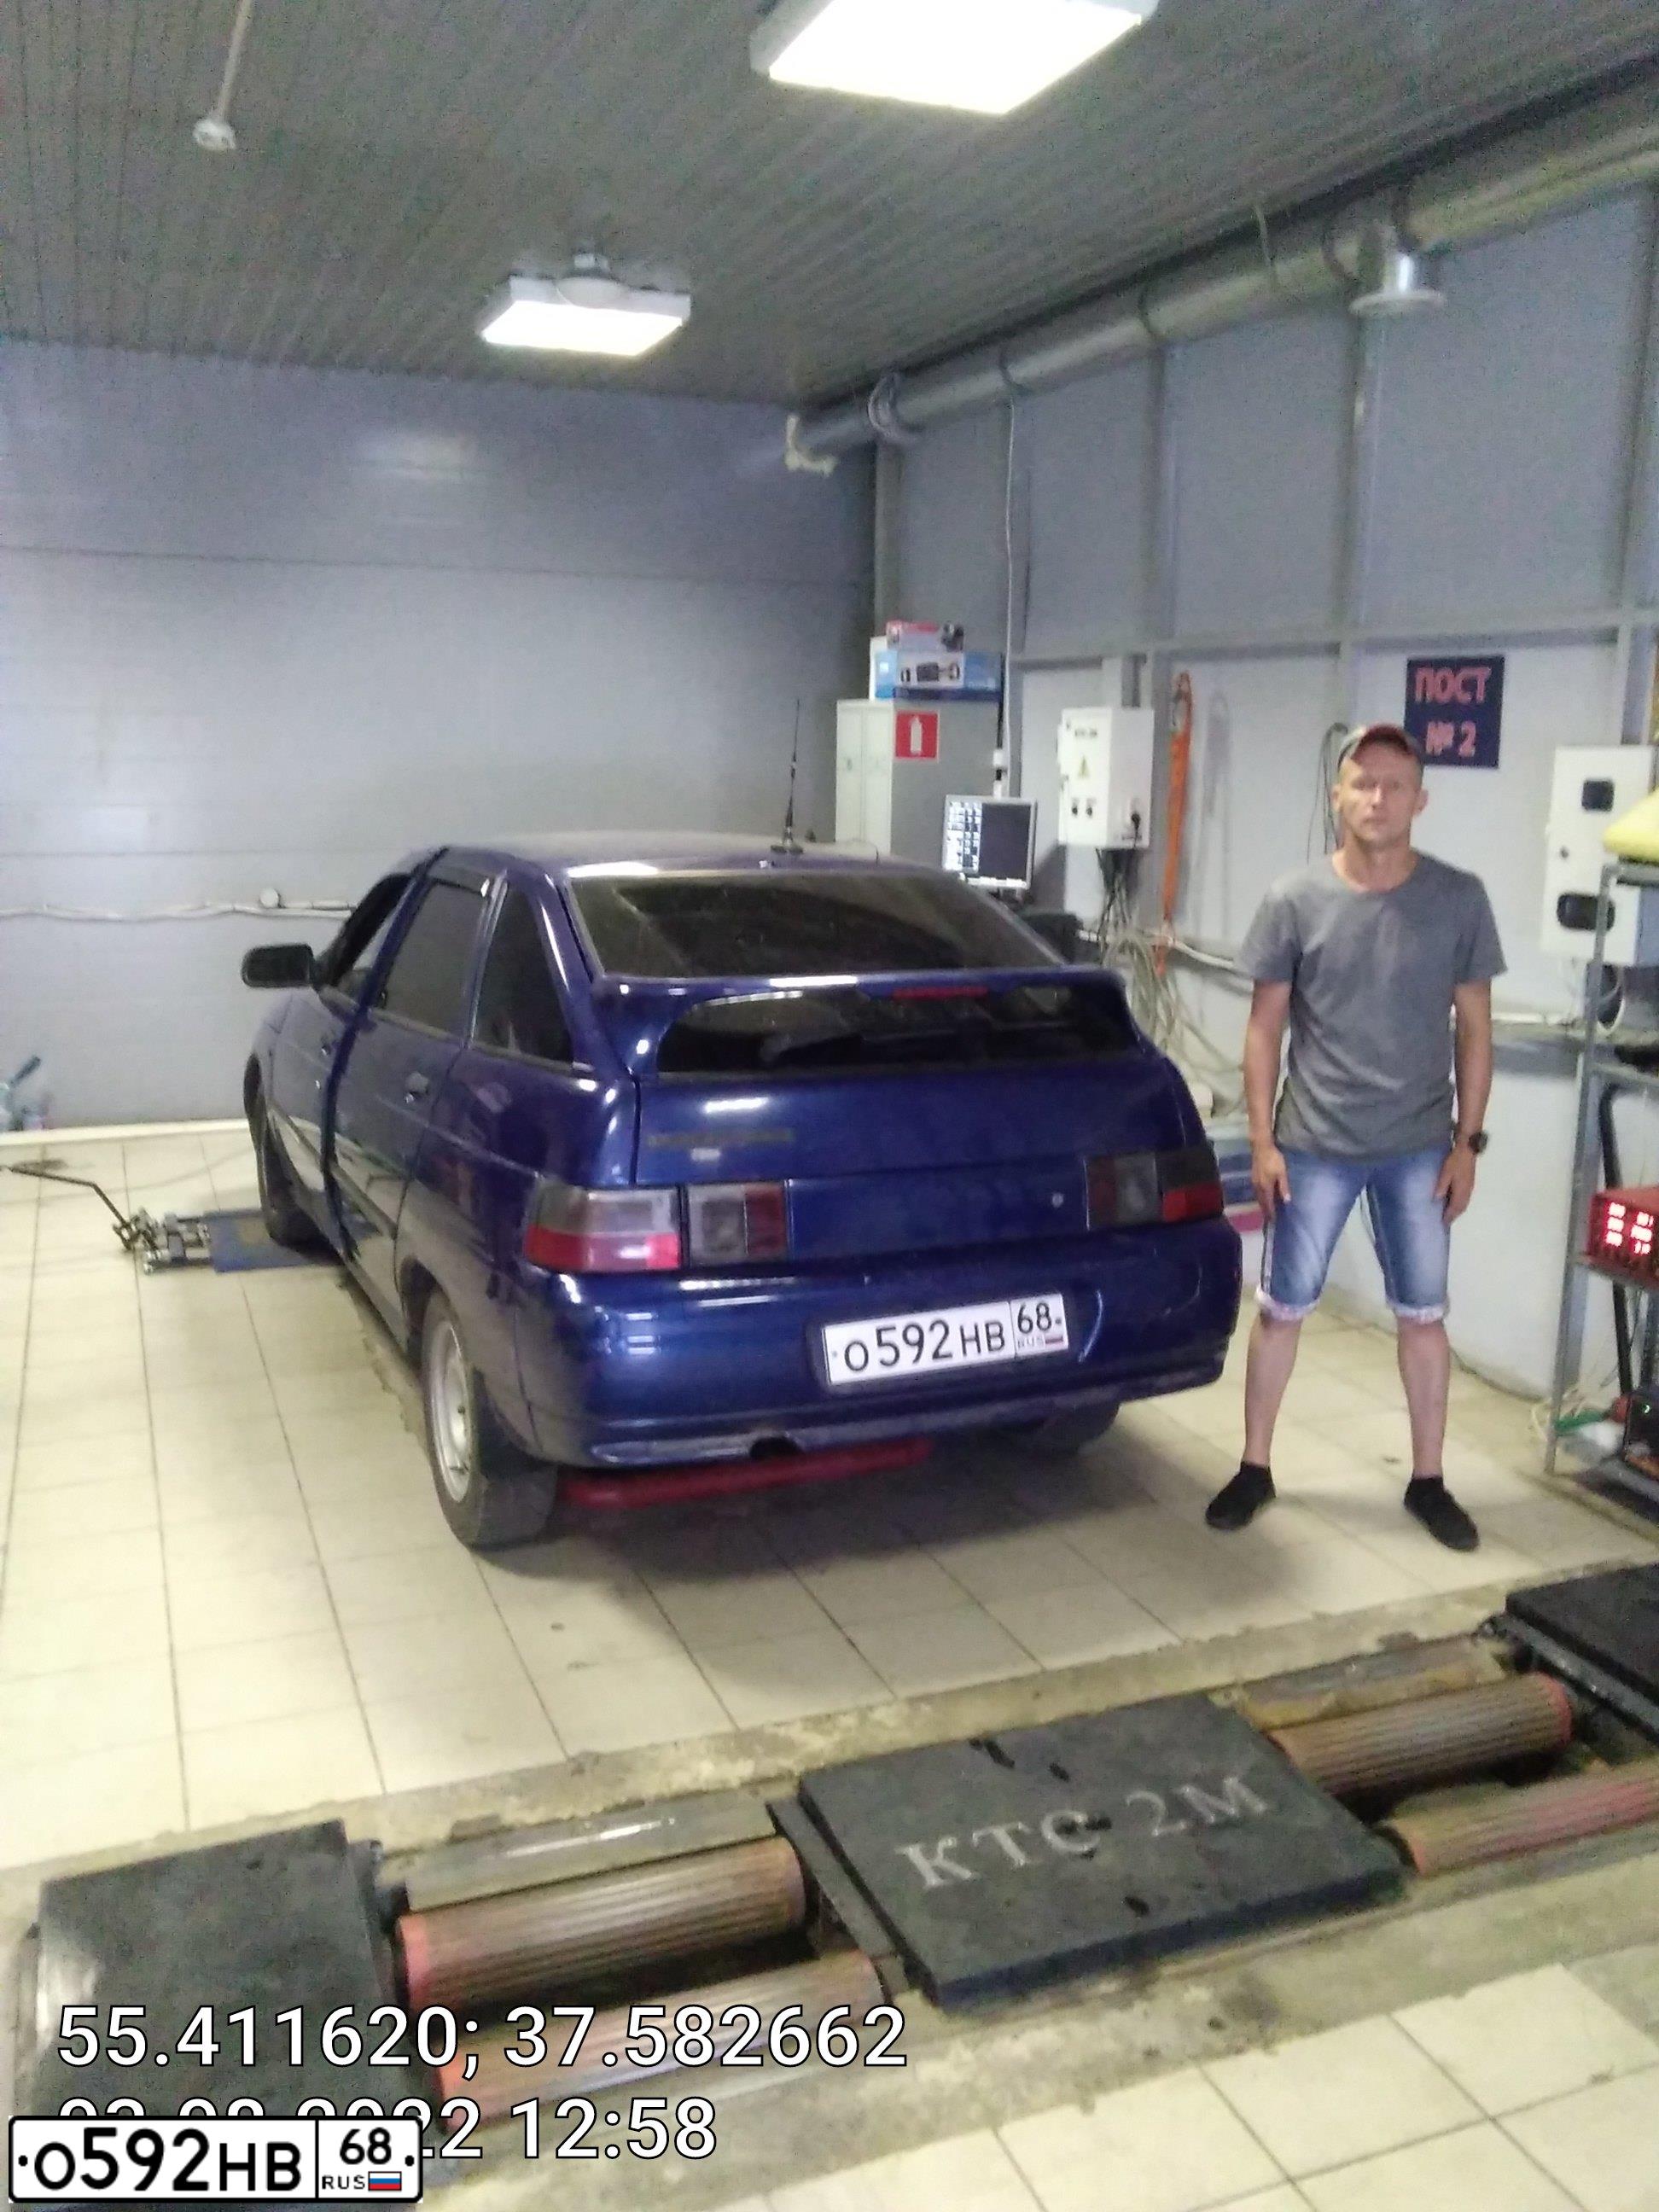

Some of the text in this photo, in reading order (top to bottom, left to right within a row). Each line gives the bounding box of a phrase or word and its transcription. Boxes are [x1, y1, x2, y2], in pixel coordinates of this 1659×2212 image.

[1415, 666, 1492, 703] ПОСТ
[1458, 721, 1476, 757] 2
[844, 1302, 1051, 1372] О592НВ 68
[894, 1776, 1268, 1889] КТС 2М
